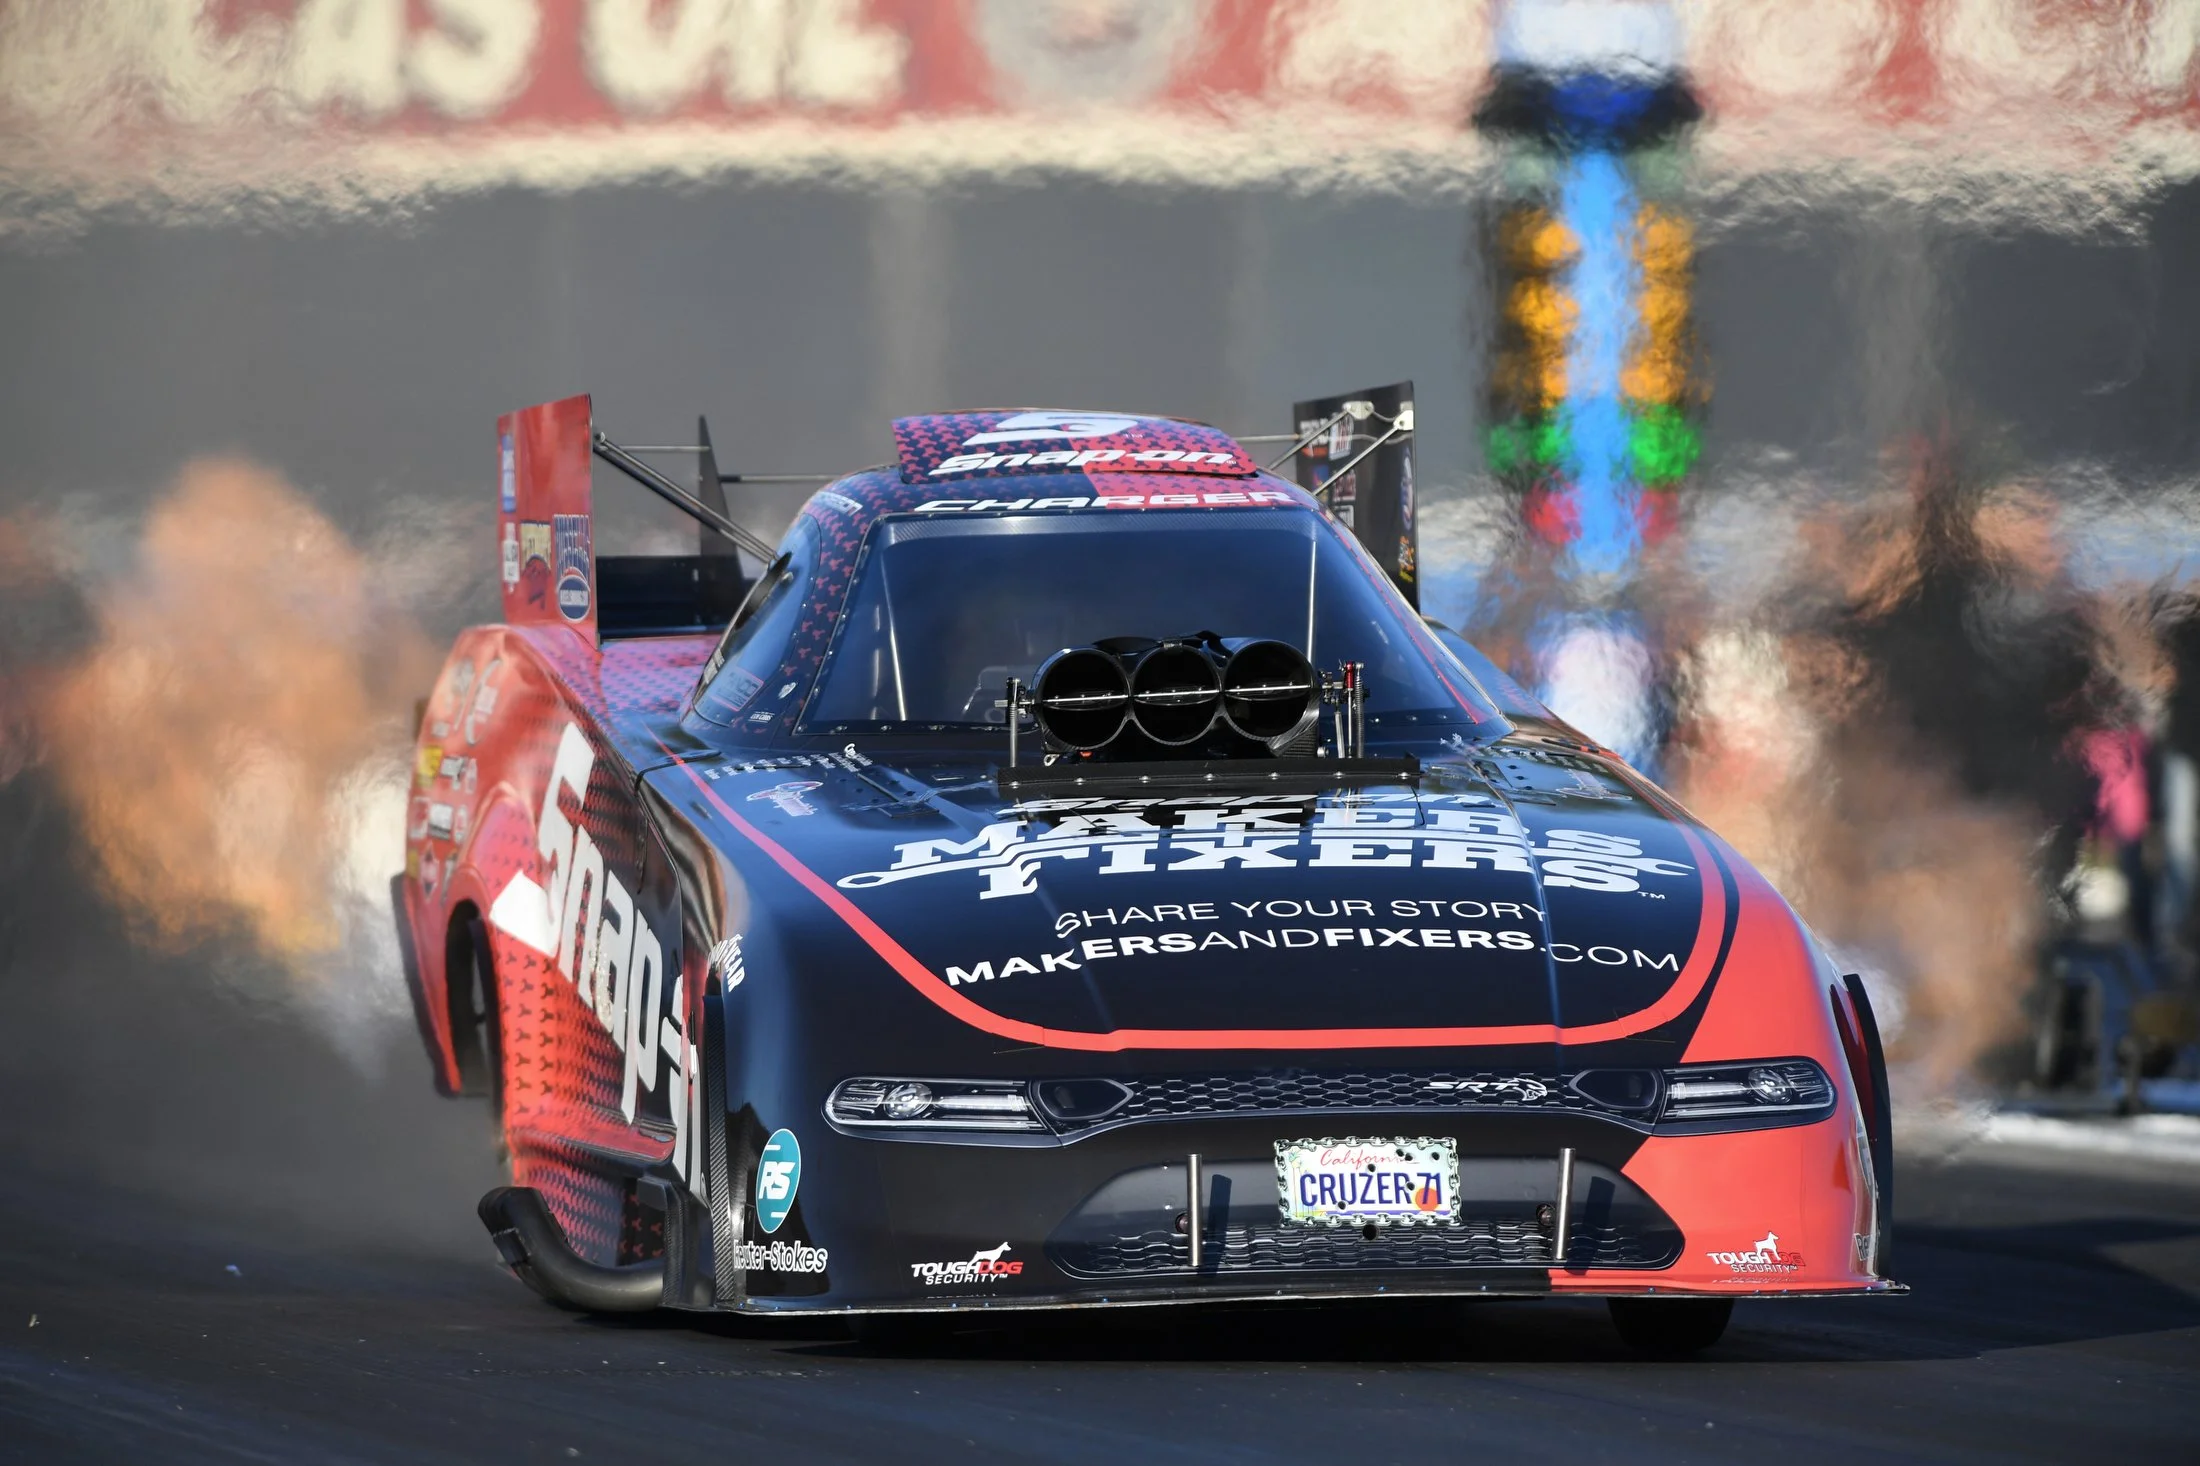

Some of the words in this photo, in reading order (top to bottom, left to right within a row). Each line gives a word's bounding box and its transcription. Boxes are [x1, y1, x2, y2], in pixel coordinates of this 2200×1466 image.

[928, 449, 1232, 476] Snap-on
[914, 491, 1297, 512] CHARGER
[890, 808, 1643, 870] MAKERS
[978, 838, 1641, 900] FIXERS
[1055, 902, 1219, 938] SHARE
[1231, 900, 1375, 918] YOUR
[1391, 900, 1546, 922] STORY
[945, 928, 1680, 986] MAKERSANDFIXERS.COM
[1423, 1081, 1519, 1093] SRT
[759, 1161, 795, 1199] RS
[734, 1239, 828, 1273] Reuter-Stokes
[1731, 1263, 1791, 1273] SECURITY
[925, 1273, 998, 1285] SECURITY
